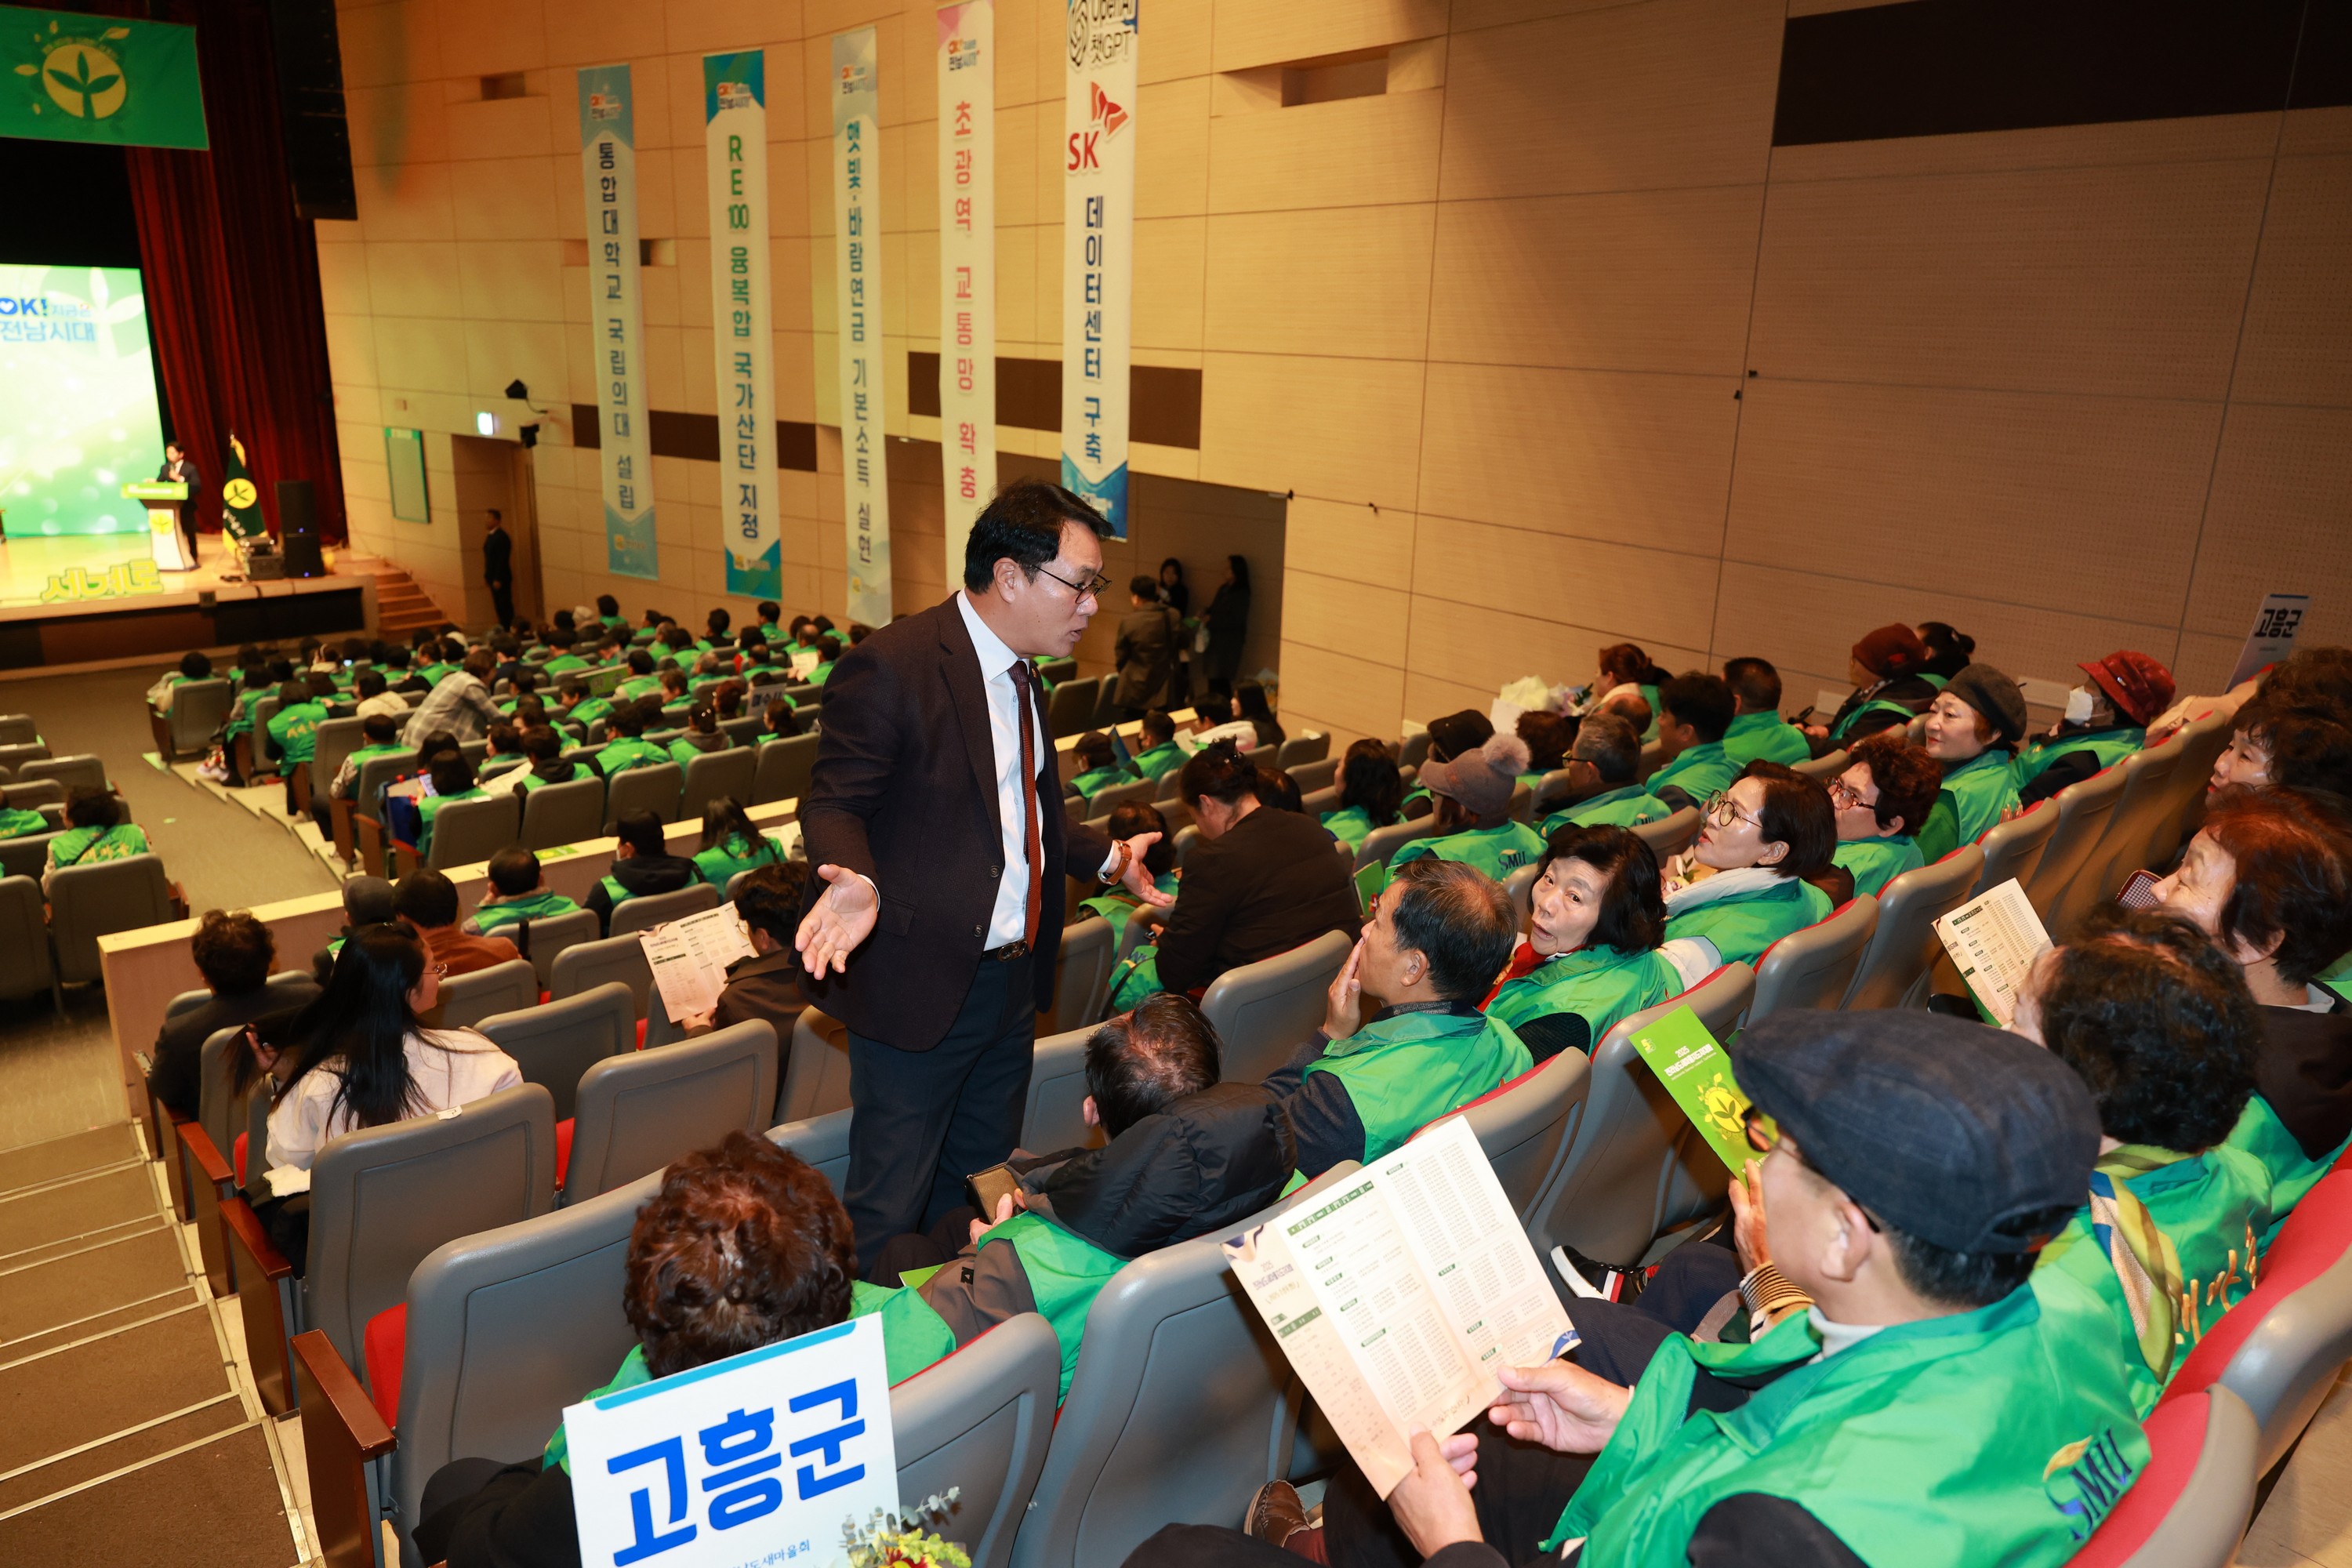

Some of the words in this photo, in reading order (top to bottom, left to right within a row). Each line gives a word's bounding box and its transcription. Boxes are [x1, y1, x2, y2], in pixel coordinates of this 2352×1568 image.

[1091, 30, 1131, 64] 챗GPT
[954, 100, 972, 232] 초광역
[1068, 130, 1099, 171] SK
[599, 142, 622, 300] 통합대학교
[731, 246, 751, 338] 융복합
[955, 267, 973, 390] 교통망
[1084, 195, 1104, 379] 데이터센터
[0, 321, 96, 342] 전남시대
[608, 318, 630, 437] 국립의대
[734, 352, 756, 470] 국가산단
[853, 358, 869, 488] 기본소득
[960, 422, 976, 499] 확충
[1084, 397, 1102, 465] 구축
[617, 455, 634, 510] 설립
[739, 484, 759, 539] 지정
[858, 502, 872, 564] 실현
[42, 560, 163, 601] 세계로
[2254, 608, 2303, 638] 고흥군
[606, 1377, 866, 1567] 고흥군
[2044, 1428, 2132, 1541] SMU
